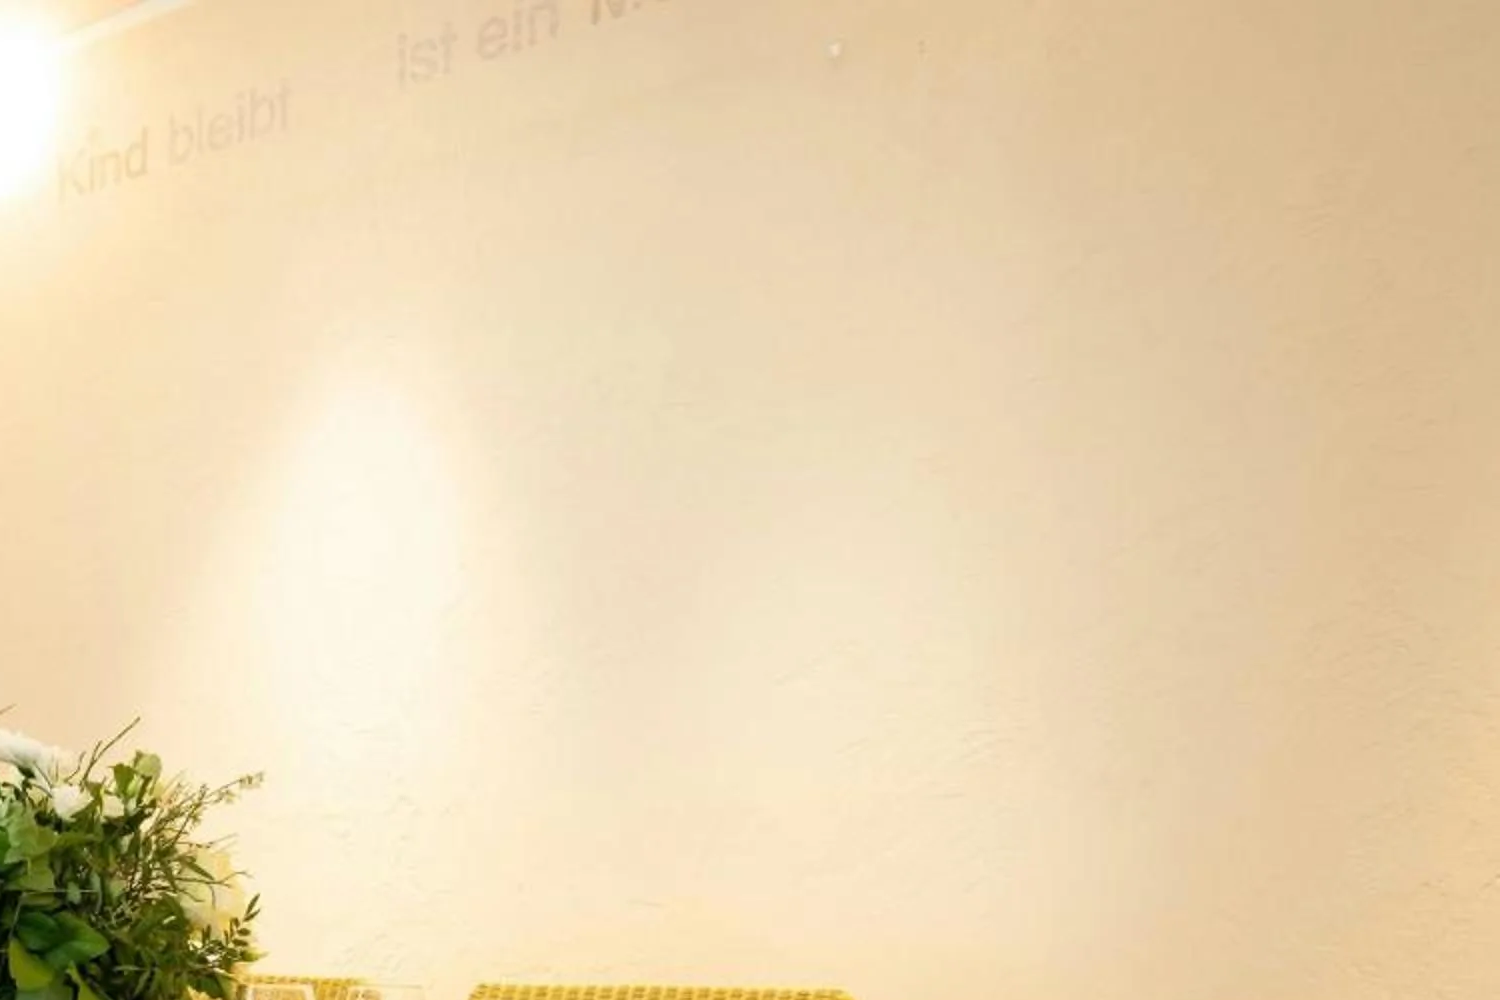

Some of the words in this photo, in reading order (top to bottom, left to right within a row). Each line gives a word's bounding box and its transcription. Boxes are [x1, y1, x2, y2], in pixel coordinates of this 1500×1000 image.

[396, 20, 457, 87] ist
[475, 0, 560, 61] ein
[57, 124, 149, 204] Kind
[166, 78, 293, 167] bleibt
